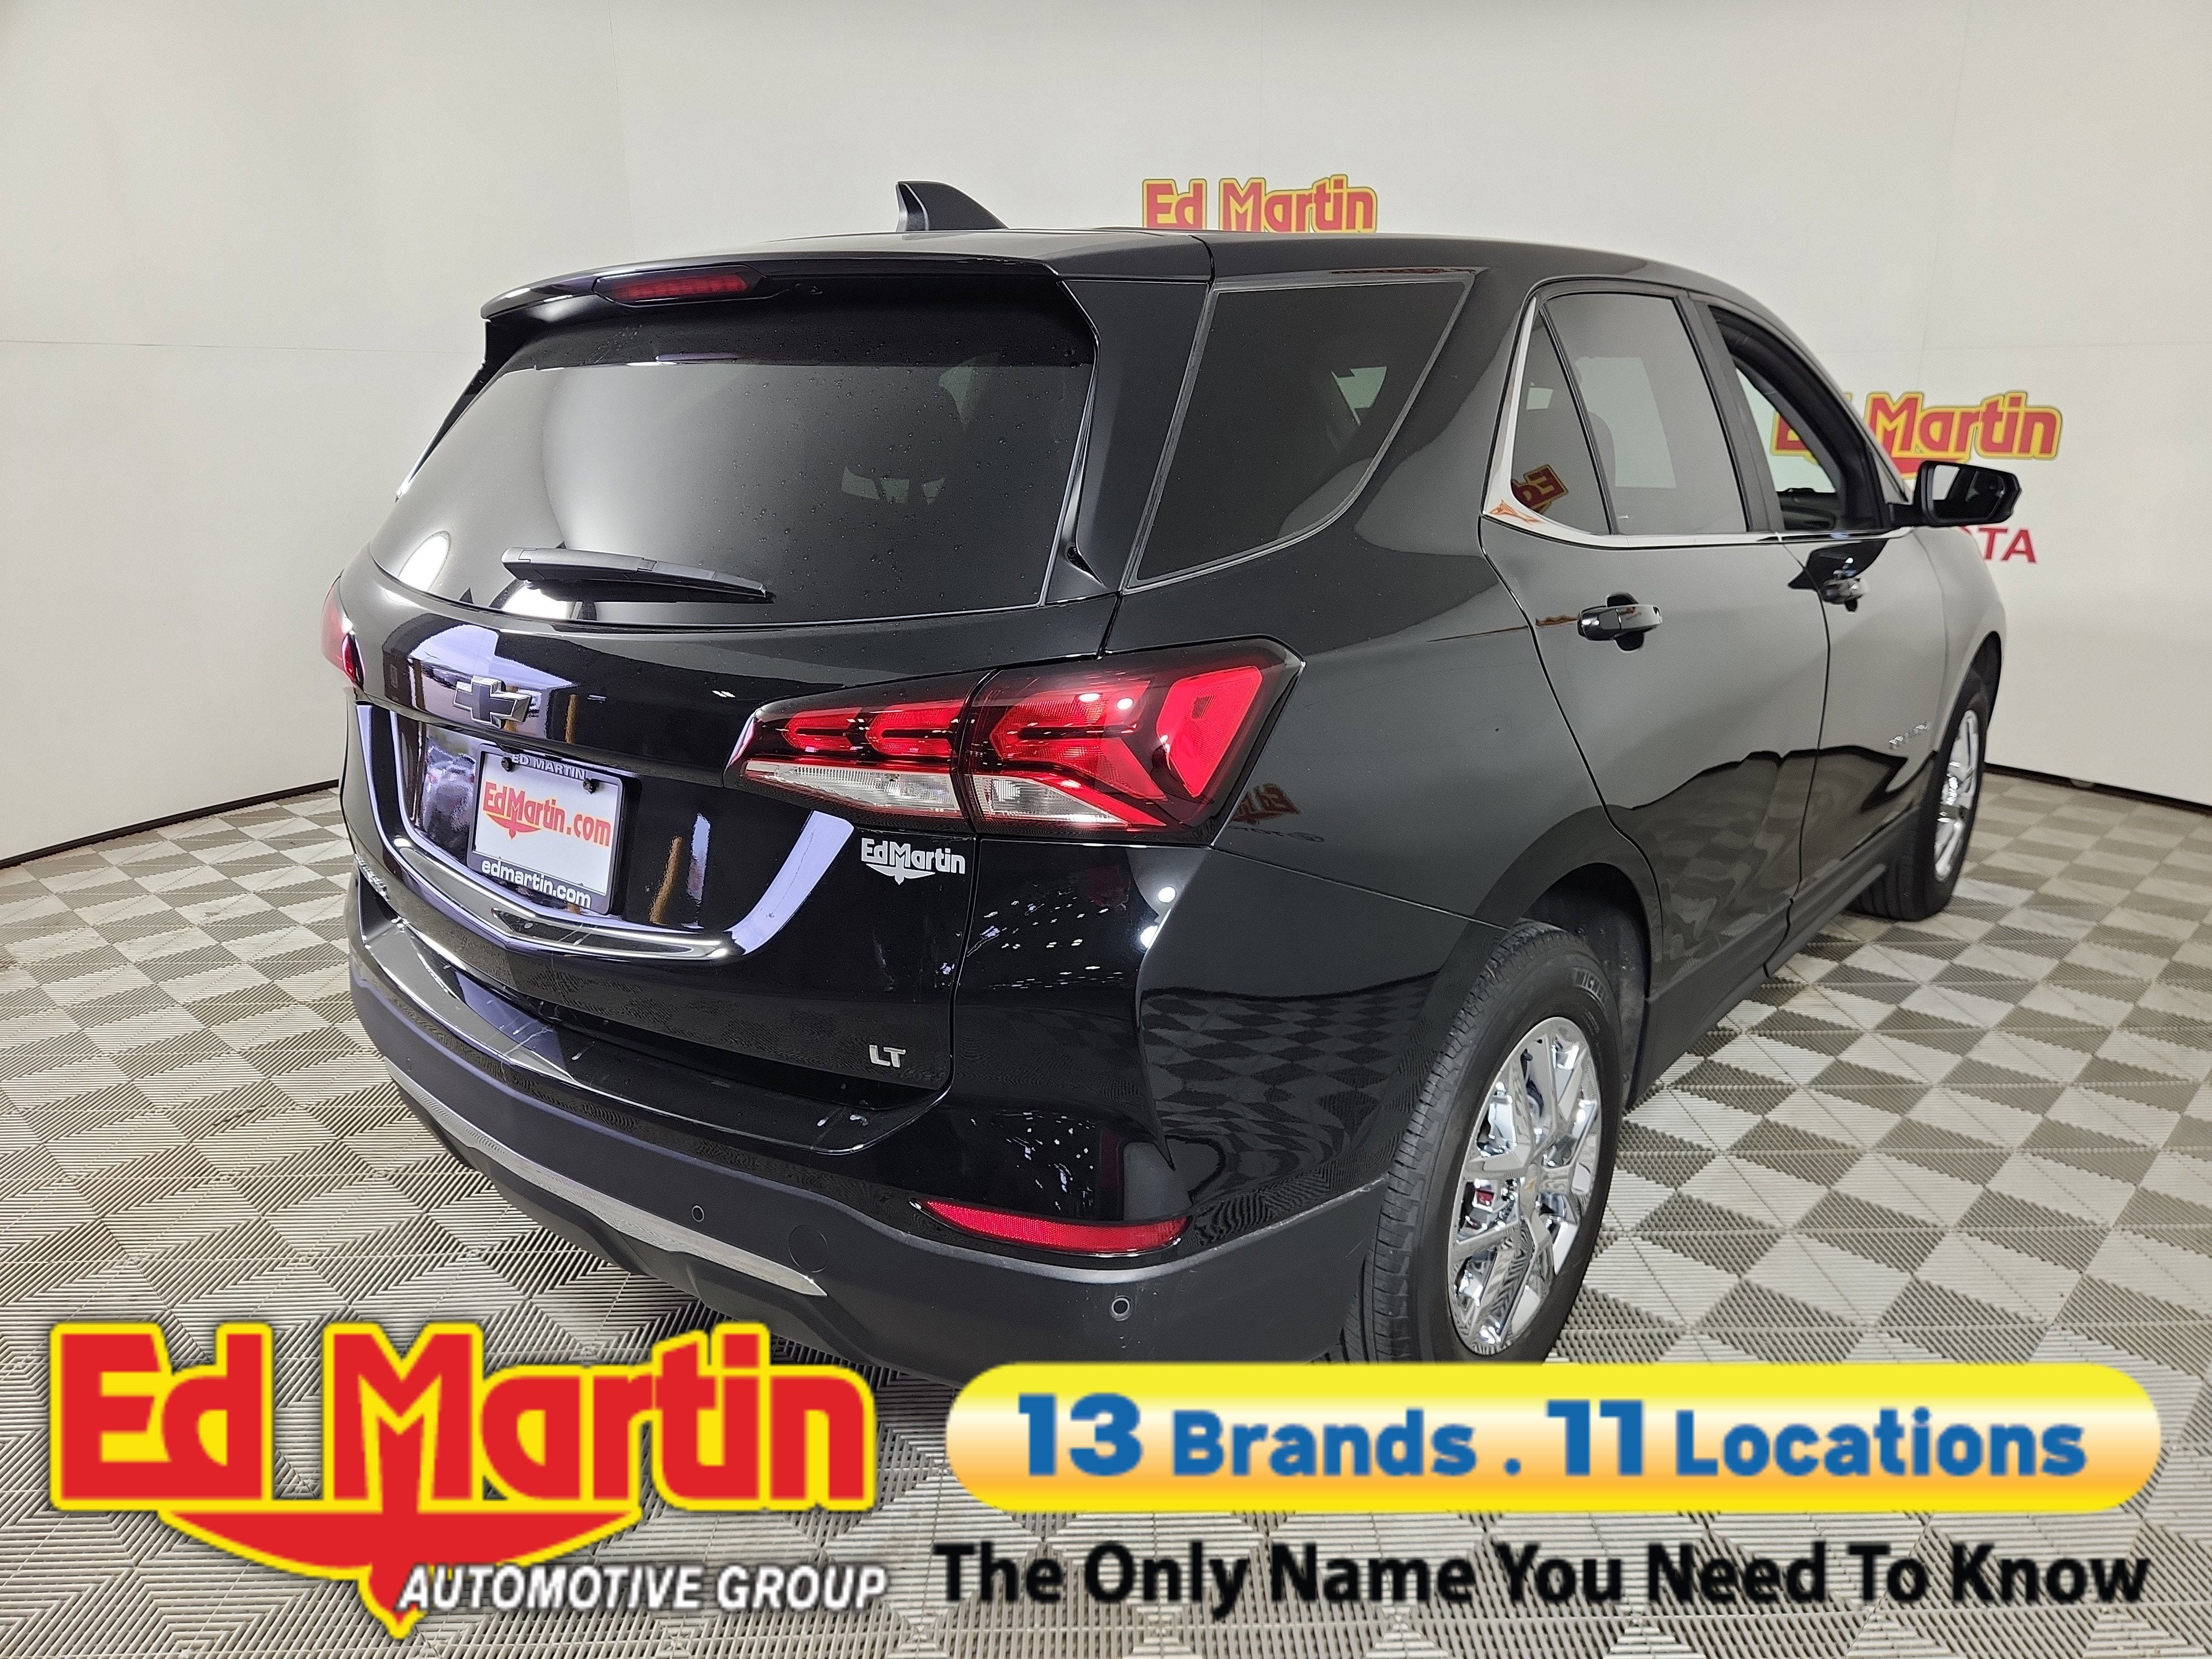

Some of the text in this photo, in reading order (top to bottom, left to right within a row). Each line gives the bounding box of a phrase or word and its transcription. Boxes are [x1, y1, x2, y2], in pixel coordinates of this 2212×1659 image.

[1143, 174, 1377, 233] Ed Martin
[1864, 392, 2062, 460] Martin
[511, 754, 587, 780] ED MARTIN
[481, 859, 591, 909] edmartin.com
[869, 1044, 906, 1068] LT
